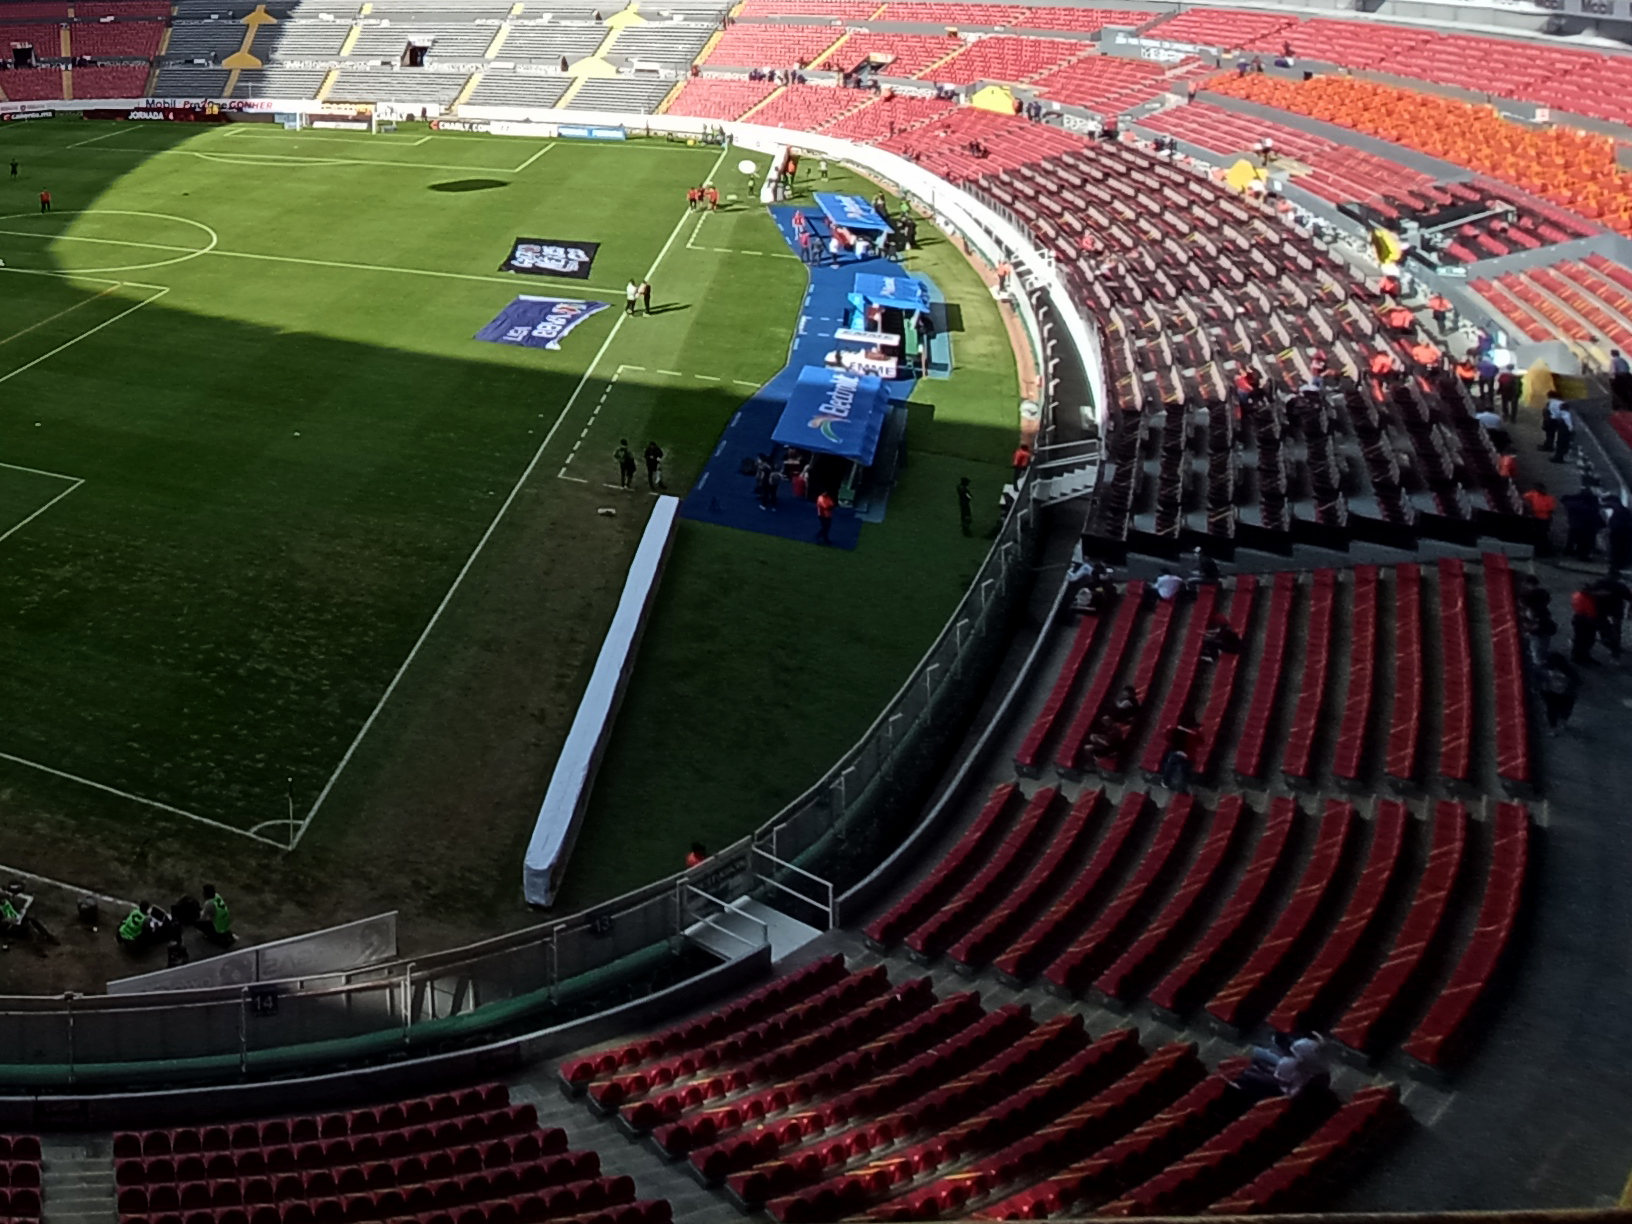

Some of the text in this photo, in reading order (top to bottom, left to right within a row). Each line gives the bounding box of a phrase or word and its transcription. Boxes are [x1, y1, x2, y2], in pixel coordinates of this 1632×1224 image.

[146, 98, 176, 109] Mobil
[229, 101, 273, 110] GONHER
[128, 111, 164, 120] JORNADA
[256, 993, 275, 1010] 14
